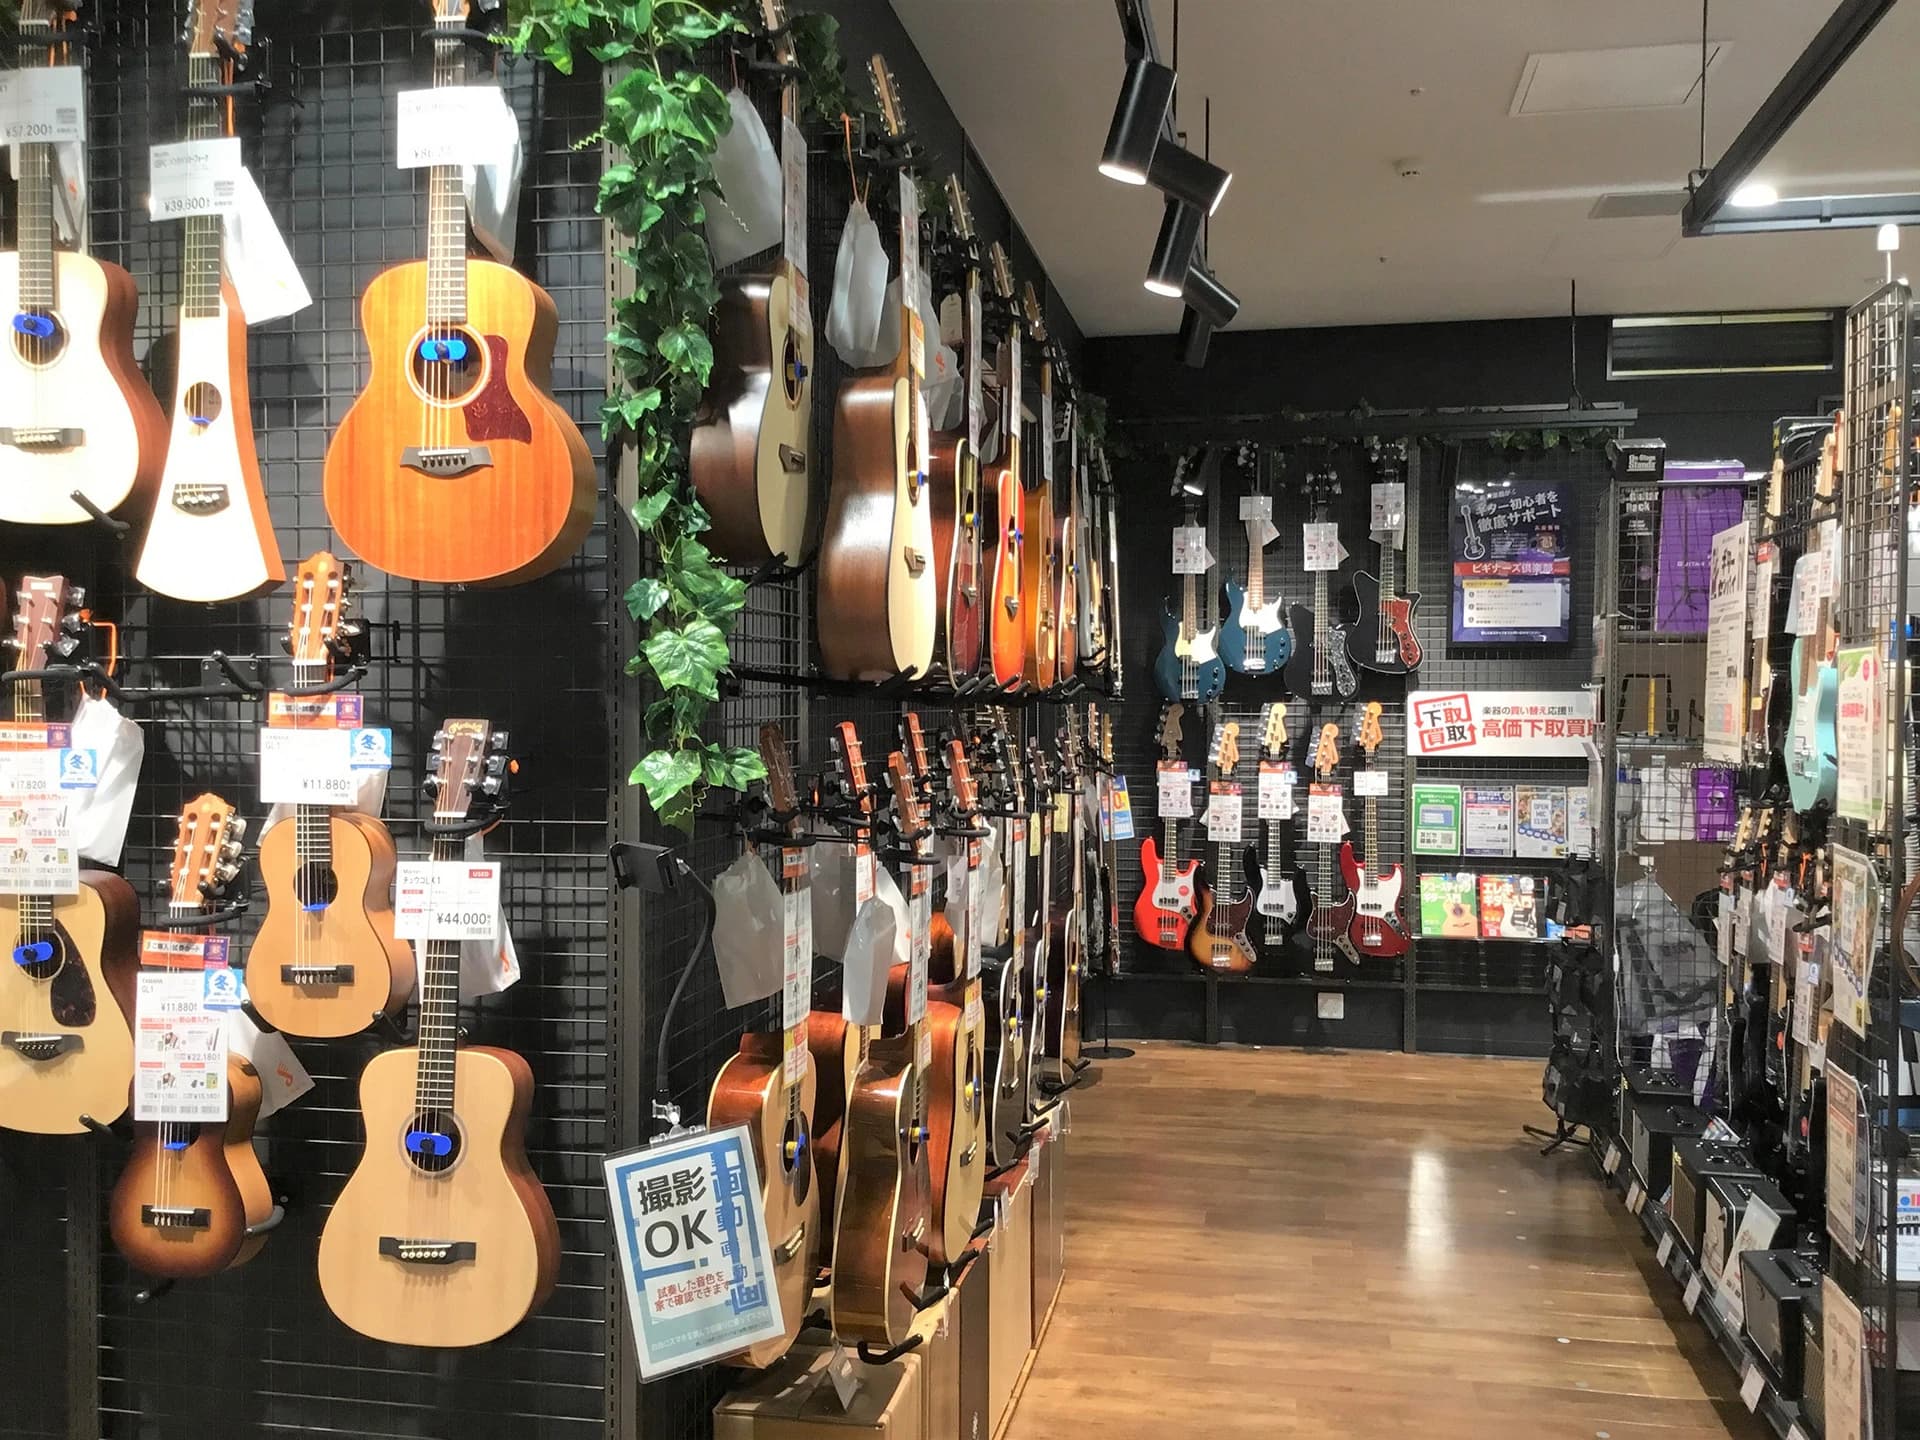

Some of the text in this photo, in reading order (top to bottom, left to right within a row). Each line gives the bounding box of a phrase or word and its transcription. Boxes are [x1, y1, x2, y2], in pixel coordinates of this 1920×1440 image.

[361, 734, 377, 750] 冬
[70, 754, 85, 770] 冬
[437, 913, 487, 925] ¥44,000
[214, 974, 229, 991] 冬
[638, 1166, 707, 1216] 撮影
[644, 1208, 713, 1259] OK
[654, 1281, 731, 1312] 家で確認できます
[657, 1271, 725, 1300] 試奏した音色を
